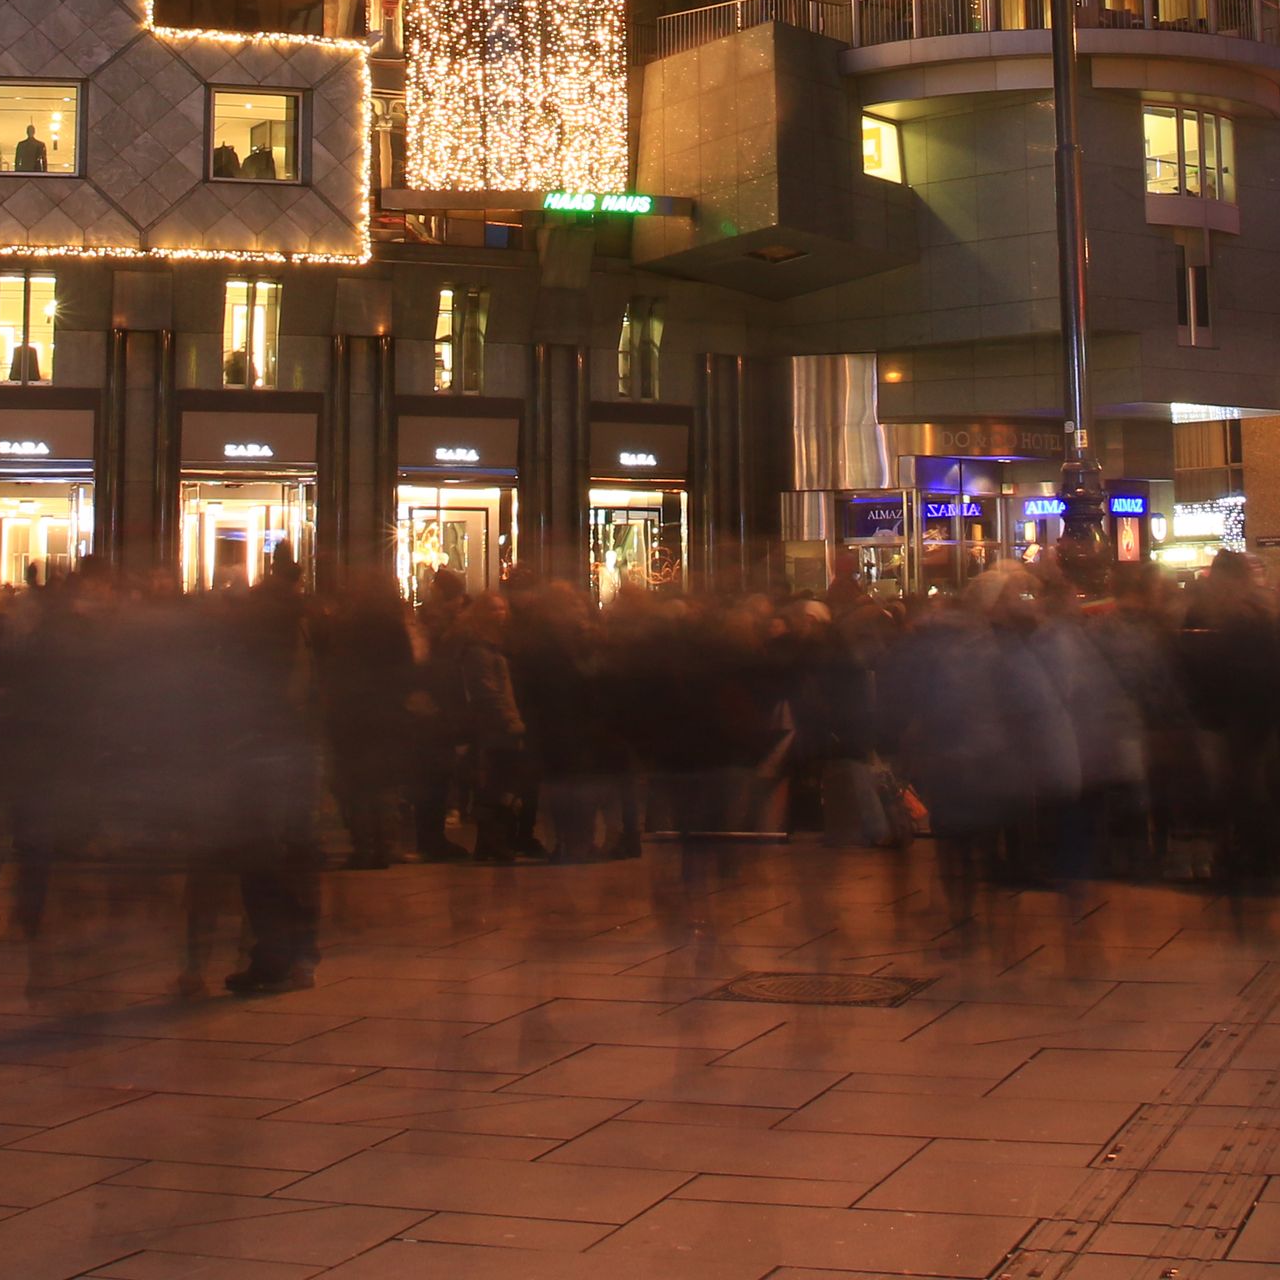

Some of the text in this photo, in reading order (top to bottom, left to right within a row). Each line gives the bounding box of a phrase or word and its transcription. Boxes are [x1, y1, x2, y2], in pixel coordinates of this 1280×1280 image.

[543, 193, 652, 213] HAAS HAUS
[1025, 499, 1066, 515] ALMA
[1111, 498, 1144, 513] ALMAZ
